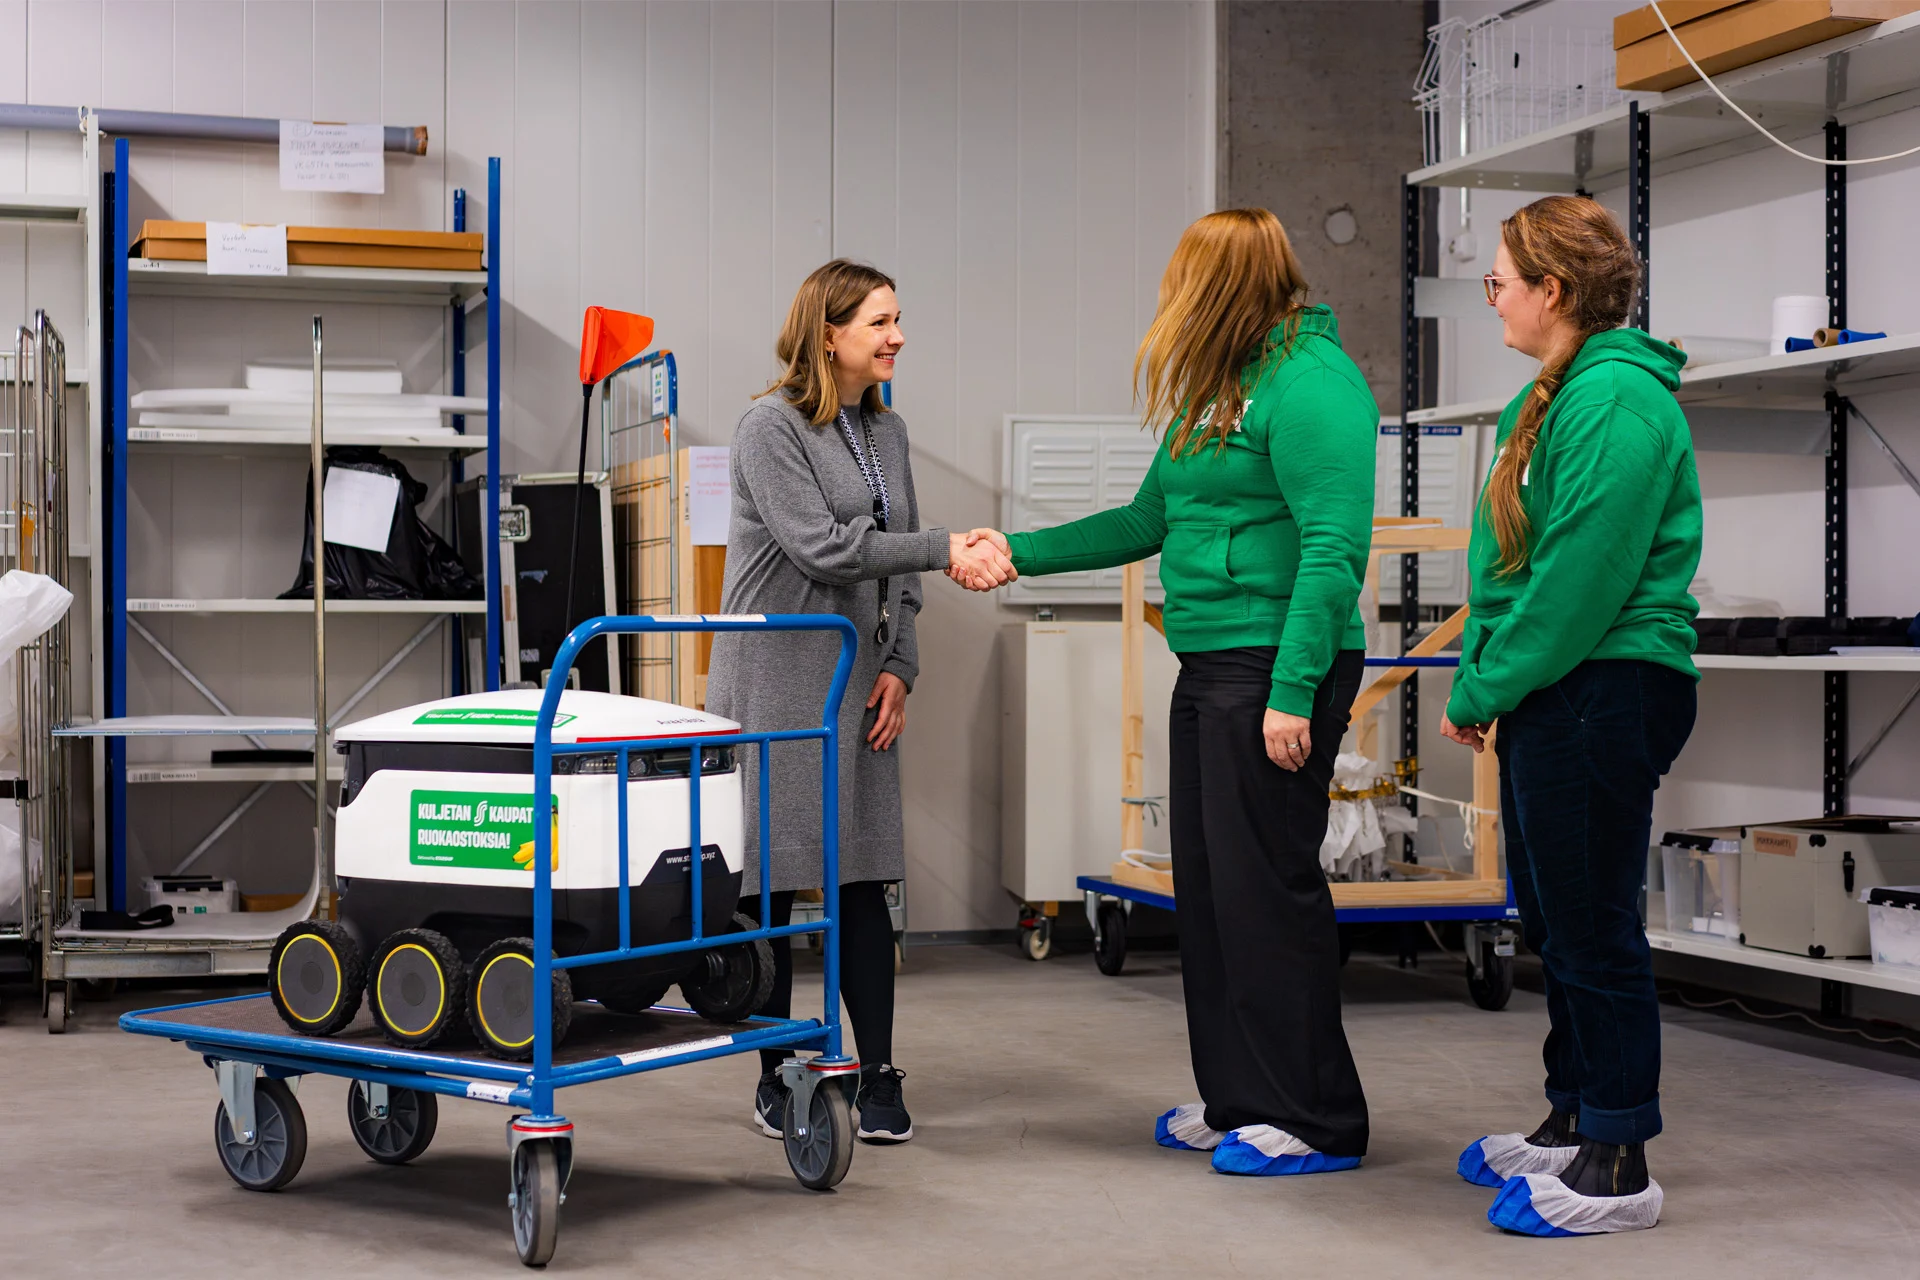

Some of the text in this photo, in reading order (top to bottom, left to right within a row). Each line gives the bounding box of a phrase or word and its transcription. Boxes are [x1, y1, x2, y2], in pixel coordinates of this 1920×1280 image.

[418, 803, 472, 821] KULJETAN
[489, 806, 534, 824] KAUPAT
[418, 829, 511, 849] RUOKAOSTOKSIA!
